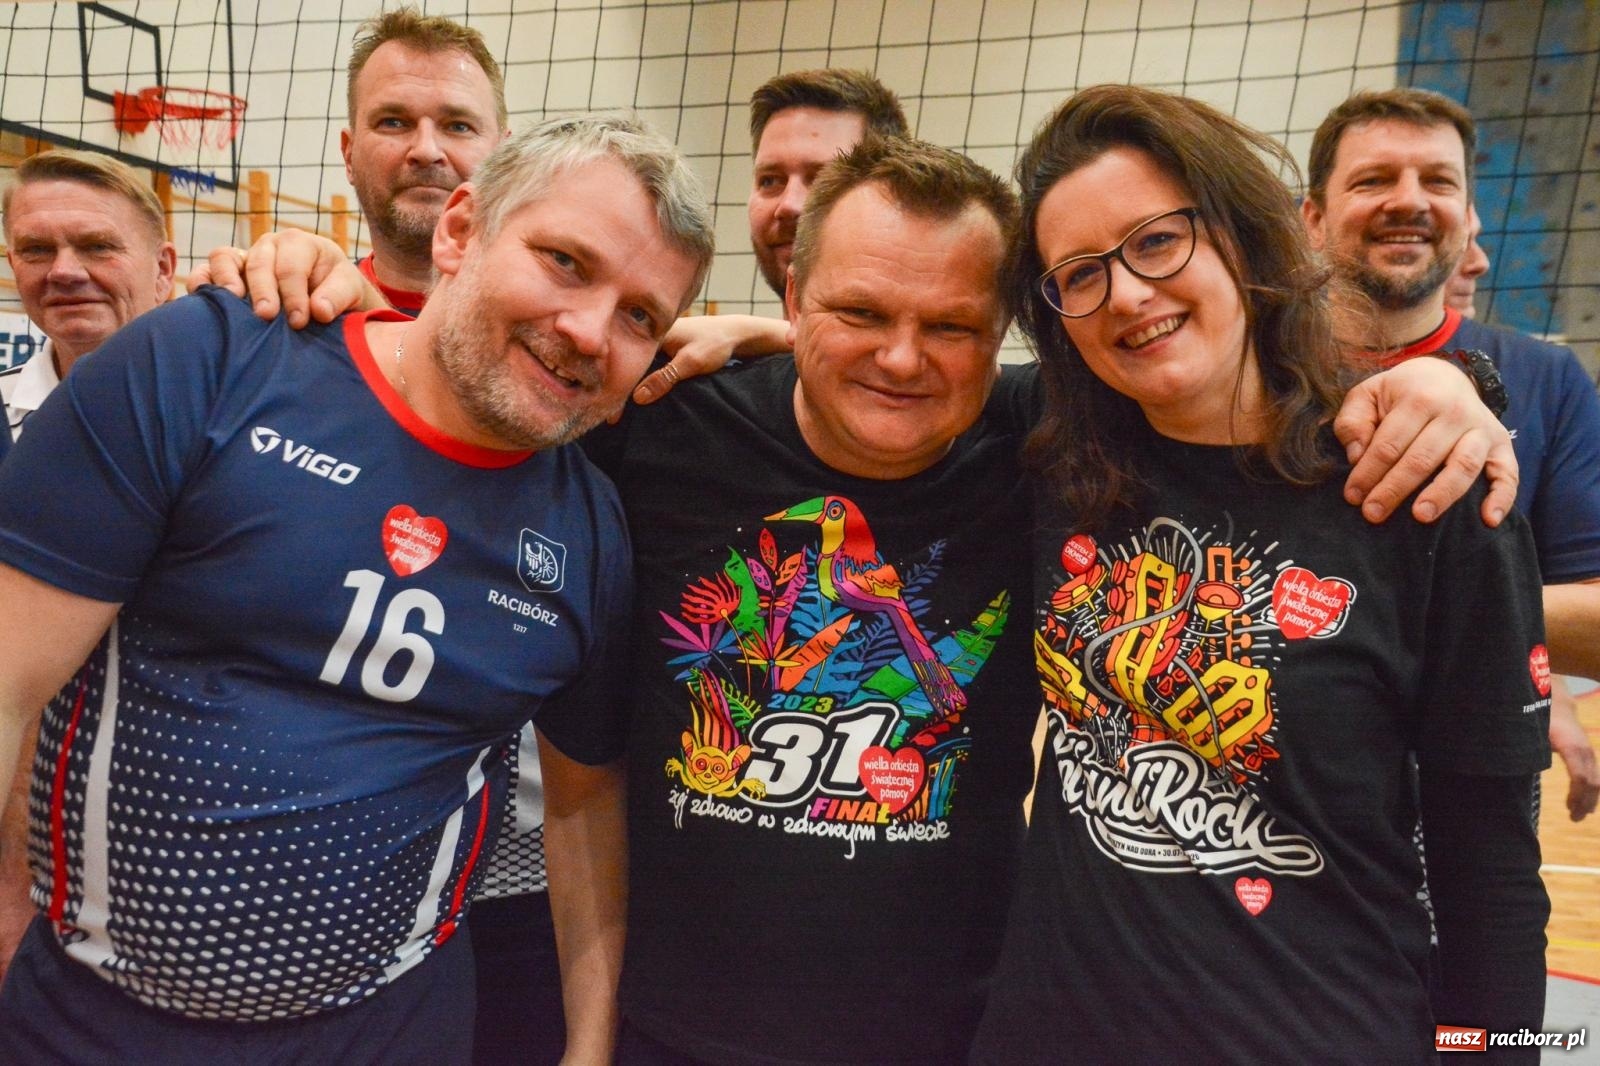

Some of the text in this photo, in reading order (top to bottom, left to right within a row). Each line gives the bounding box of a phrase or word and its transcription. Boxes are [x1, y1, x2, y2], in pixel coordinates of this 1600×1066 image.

[1282, 580, 1342, 608] wielka orkiestra
[488, 588, 559, 627] RACIBÓRZ
[513, 623, 528, 633] 1217
[1282, 612, 1316, 634] pomocy
[319, 569, 445, 702] 16
[767, 693, 834, 713] 2023
[744, 705, 892, 803] 31
[864, 756, 919, 773] wielka orkiestra
[871, 770, 914, 792] świątecznej
[881, 788, 909, 803] pomocy
[809, 797, 891, 824] FINAŁ
[690, 793, 753, 823] zdrowo
[758, 814, 776, 829] w
[783, 804, 876, 859] zdrowym
[885, 817, 950, 841] świecie
